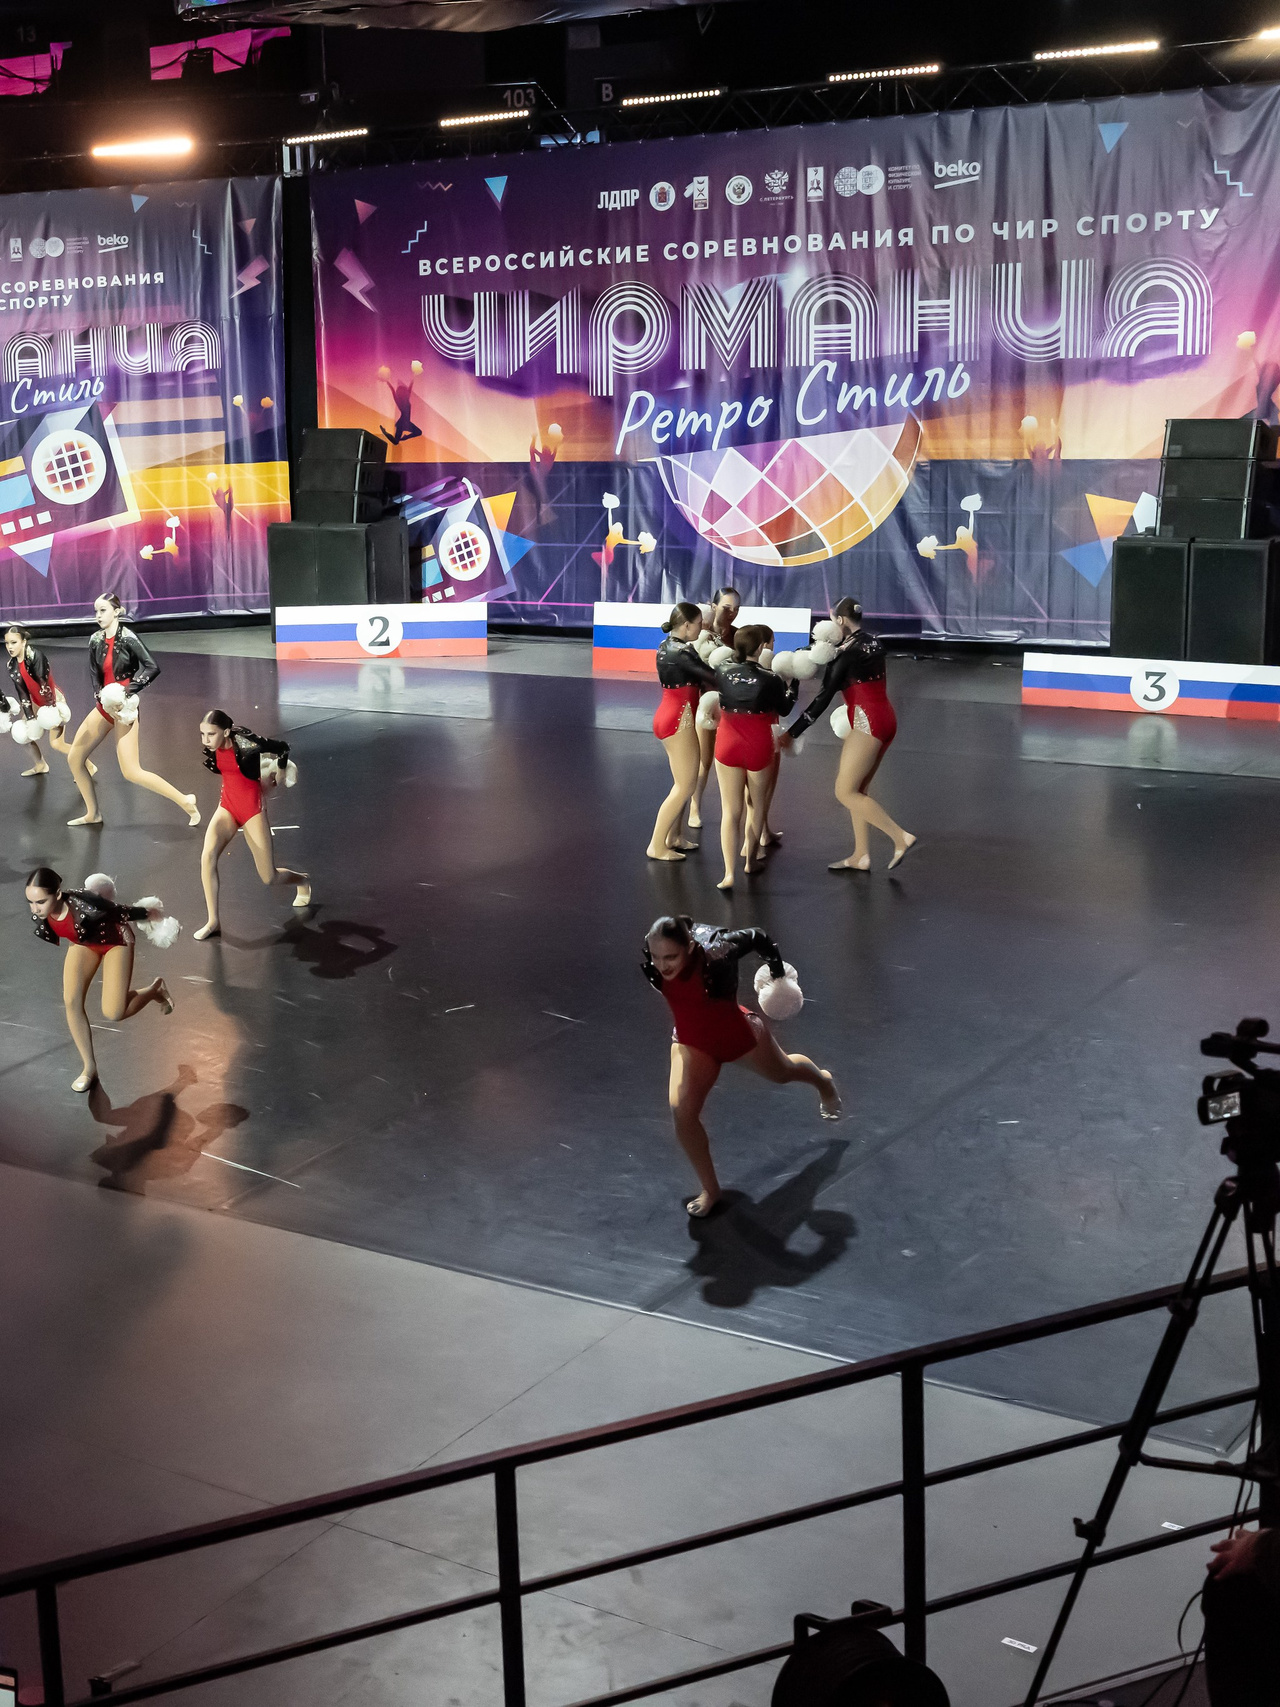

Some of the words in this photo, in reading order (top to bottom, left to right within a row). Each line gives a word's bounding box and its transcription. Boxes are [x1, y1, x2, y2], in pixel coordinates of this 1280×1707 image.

[17, 25, 36, 42] 13
[503, 88, 536, 108] 103
[934, 160, 980, 178] beko
[597, 189, 640, 211] ЛДПР
[97, 233, 129, 246] beko
[419, 244, 650, 276] ВСЕРОССИЙСКИЕ
[663, 227, 914, 261] СОРЕВНОВАНИЯ
[932, 223, 975, 245] ПО
[992, 219, 1059, 240] ЧИР
[1076, 208, 1220, 236] СПОРТУ
[1, 272, 164, 294] СОРЕВНОВАНИЯ
[11, 376, 105, 414] Стиль
[615, 390, 774, 455] Ретро
[796, 359, 971, 425] Стиль
[368, 616, 390, 647] 2
[1142, 671, 1167, 702] 3
